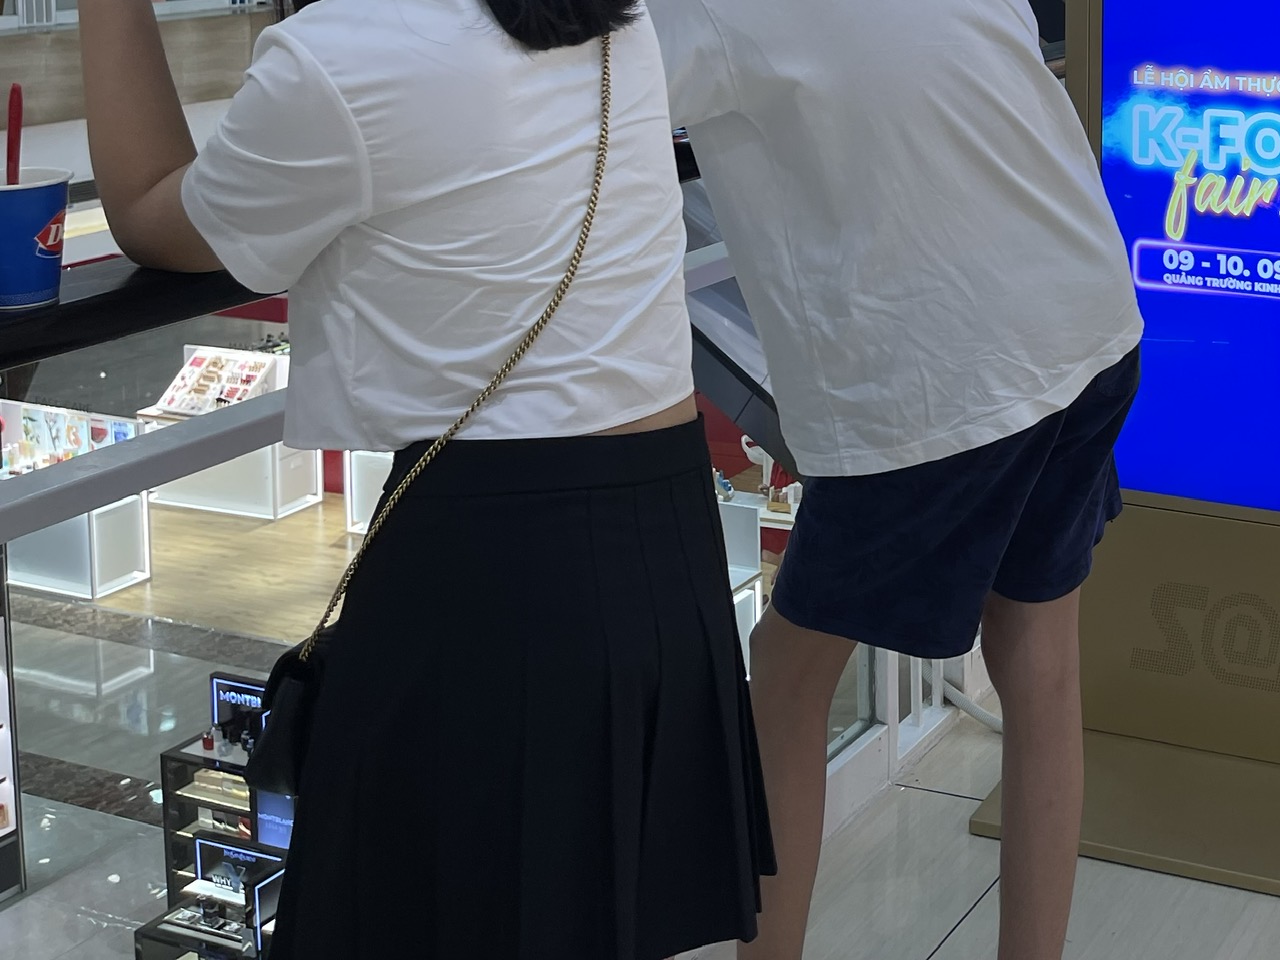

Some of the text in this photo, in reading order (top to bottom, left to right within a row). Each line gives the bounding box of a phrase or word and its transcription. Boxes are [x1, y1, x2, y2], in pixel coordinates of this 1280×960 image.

[1133, 65, 1155, 86] LỄ
[1160, 69, 1194, 91] HỘI
[1199, 69, 1230, 90] ẨM
[1164, 148, 1279, 241] fair
[1163, 248, 1195, 271] 09
[1216, 253, 1250, 277] 10.
[1163, 272, 1203, 286] QUẢNG
[1205, 276, 1252, 291] TRƯỜNG
